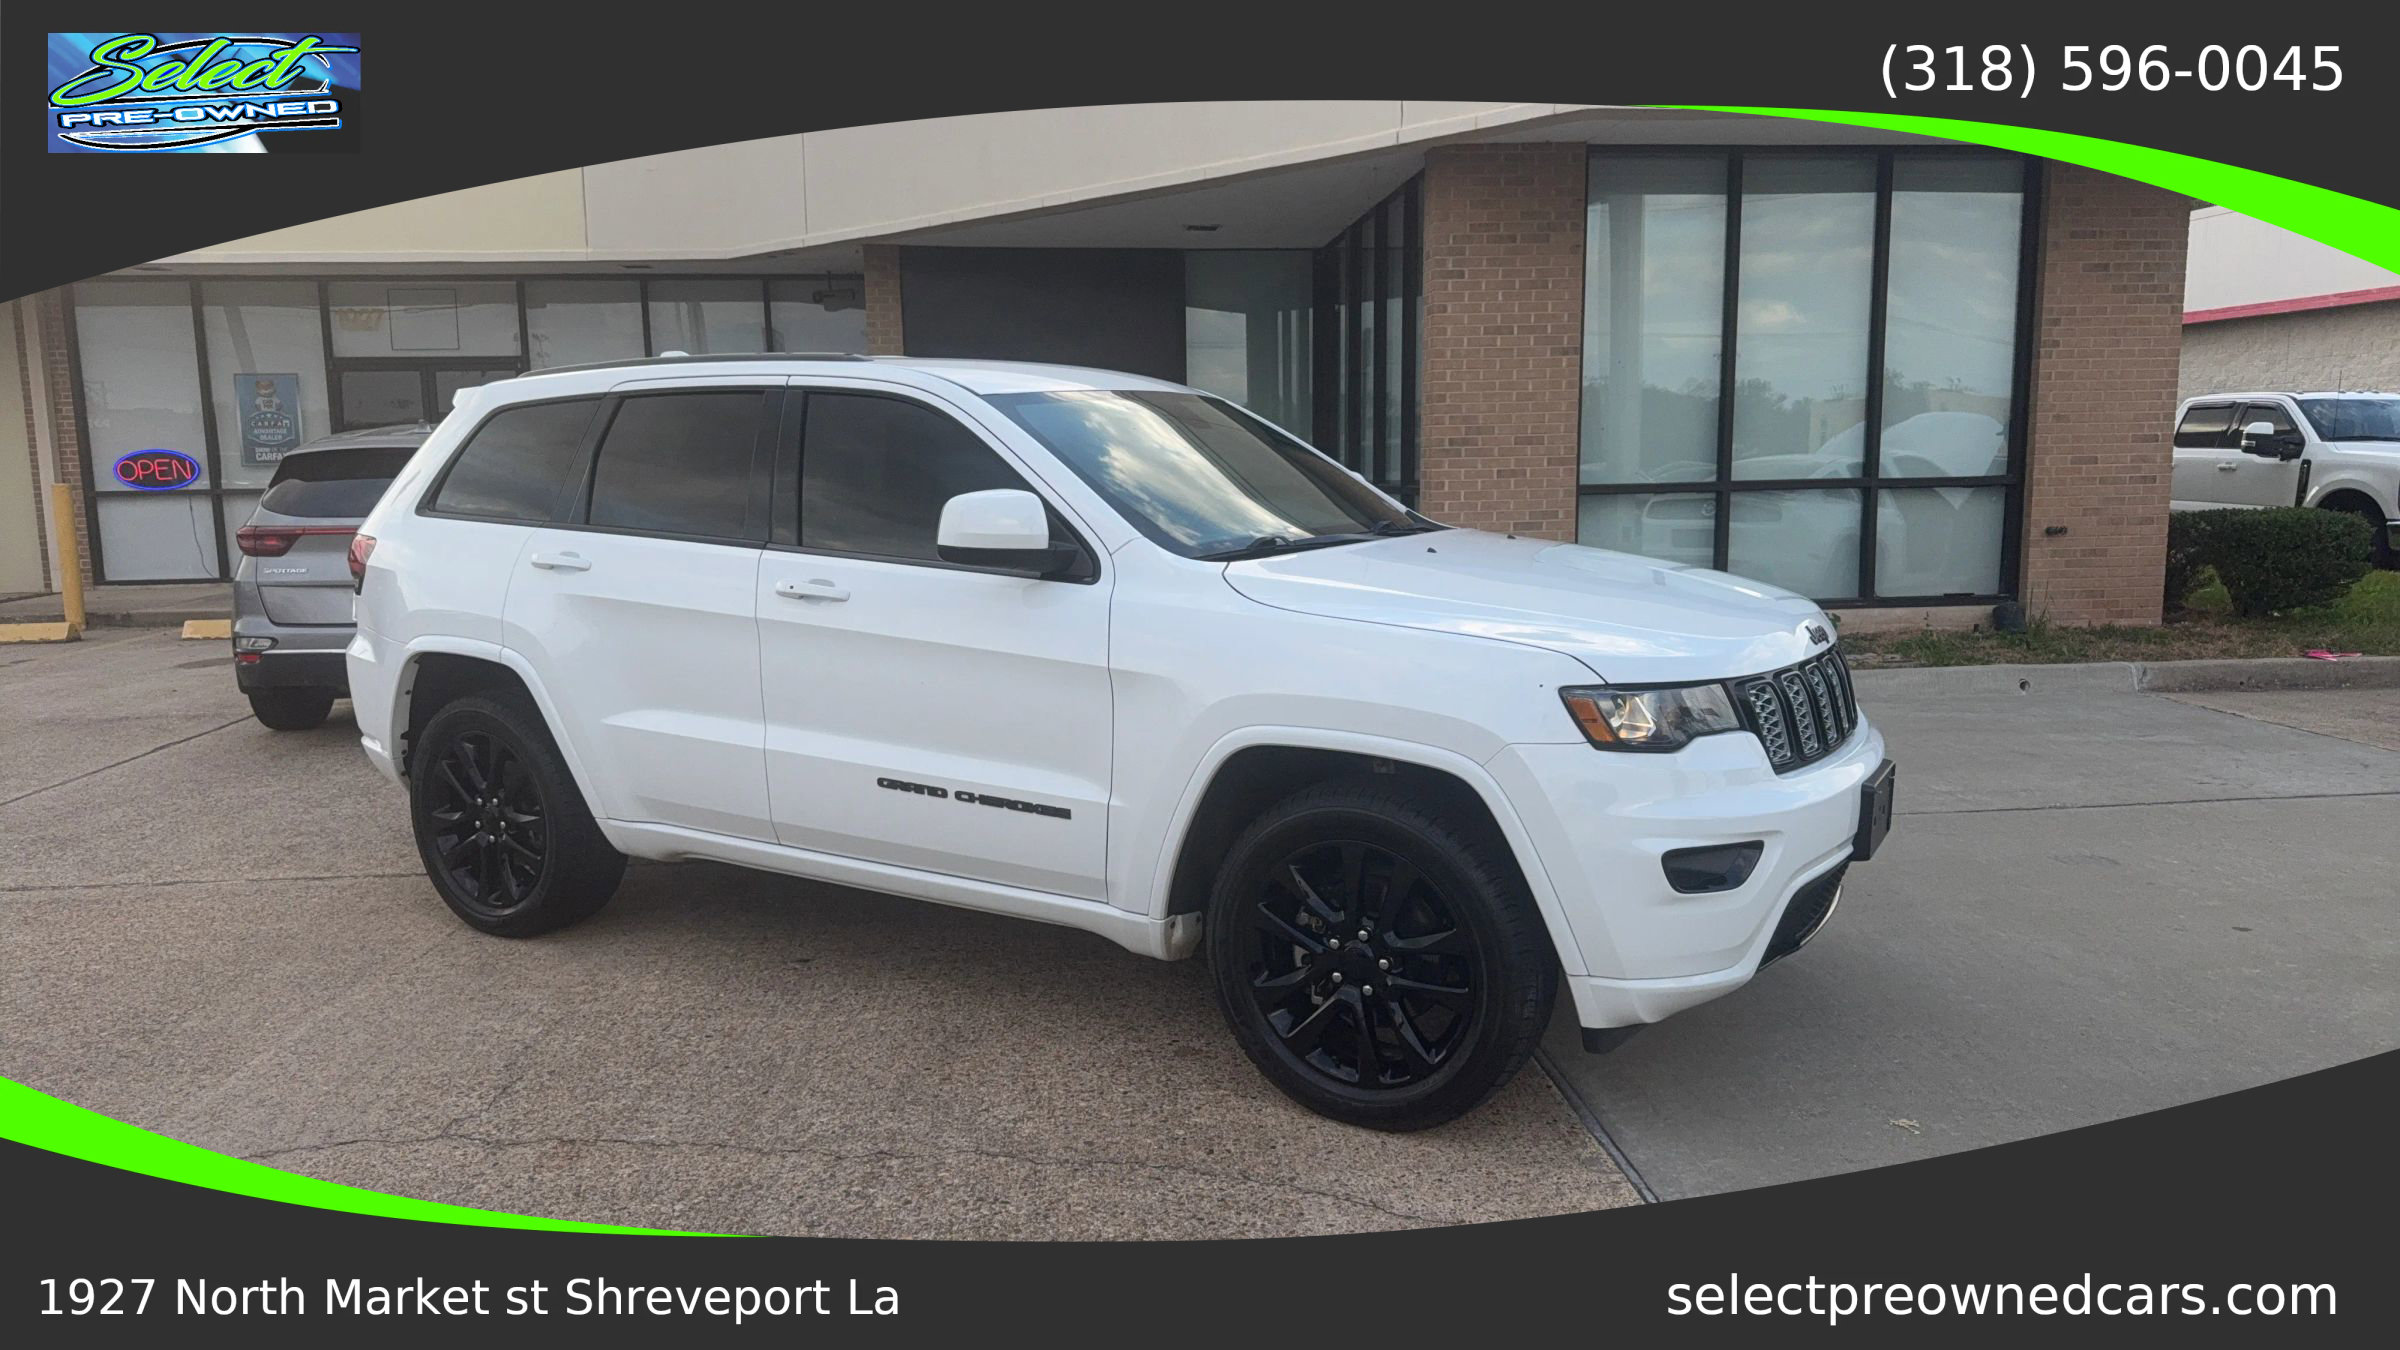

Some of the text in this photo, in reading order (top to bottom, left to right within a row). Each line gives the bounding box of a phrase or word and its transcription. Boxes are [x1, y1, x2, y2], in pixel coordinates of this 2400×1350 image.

[117, 459, 192, 481] OPEN
[1805, 625, 1830, 645] Jeep
[877, 777, 1072, 820] GRAND CHEROKEE
